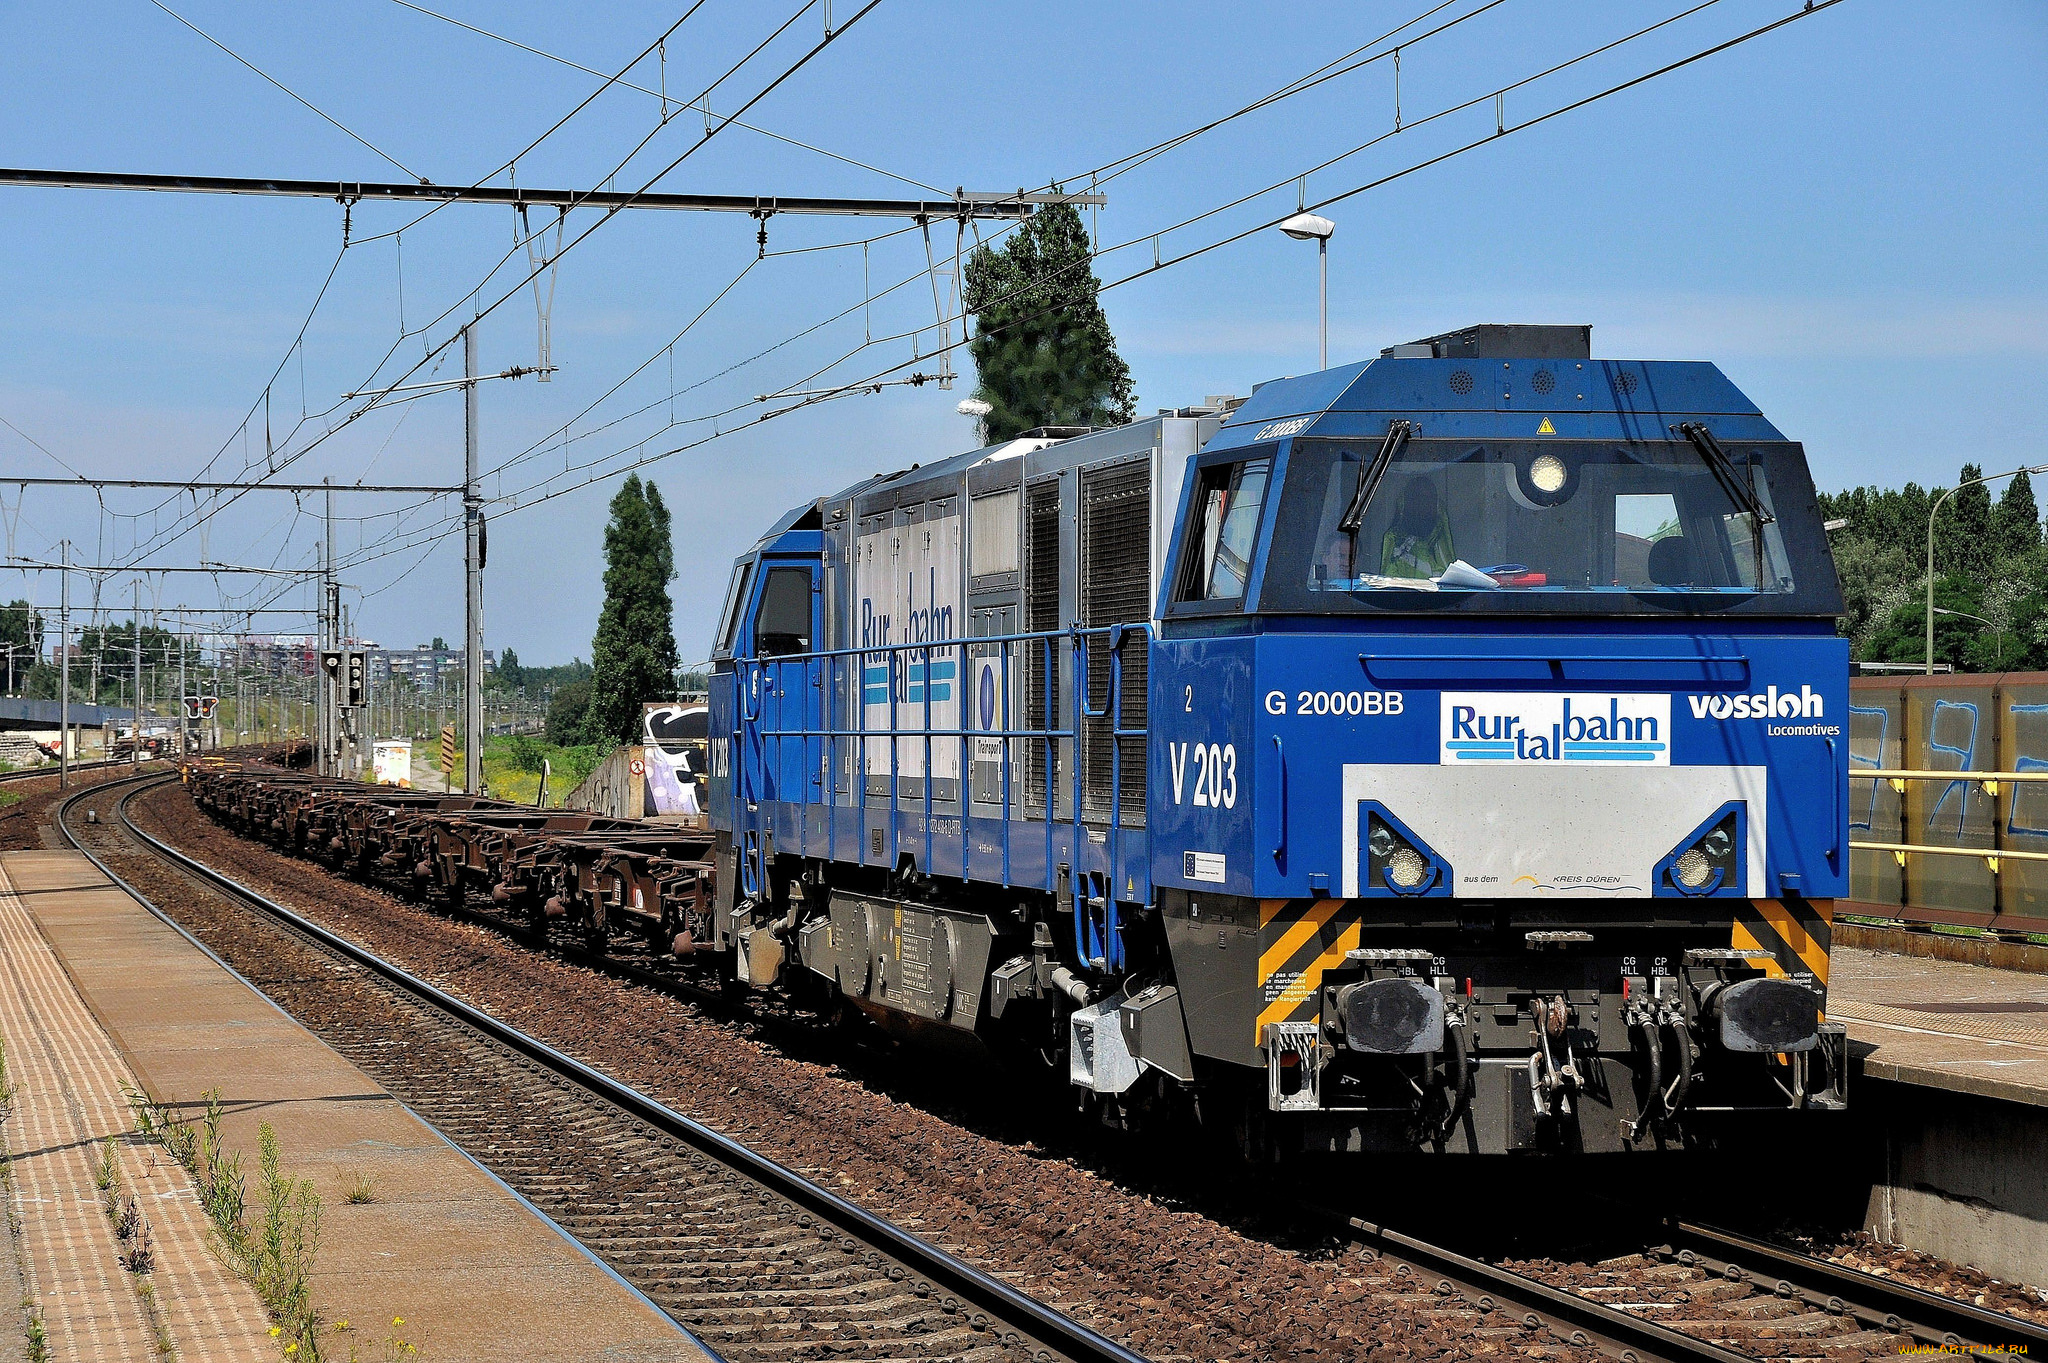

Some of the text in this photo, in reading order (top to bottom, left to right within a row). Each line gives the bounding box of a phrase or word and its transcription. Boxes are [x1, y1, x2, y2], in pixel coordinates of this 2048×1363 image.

[1185, 684, 1192, 712] 2
[1264, 690, 1404, 715] G 2000BB
[1687, 684, 1824, 720] vossloh
[1767, 723, 1841, 736] Locomotives
[1169, 742, 1237, 809] V 203
[1480, 875, 1499, 883] dem
[1585, 874, 1621, 883] DÜREN
[1432, 956, 1446, 966] CG
[1623, 956, 1636, 966] CG
[1654, 957, 1668, 966] CP
[1430, 966, 1449, 975] HLL
[1620, 966, 1639, 975] HLL
[1651, 966, 1671, 975] HBL
